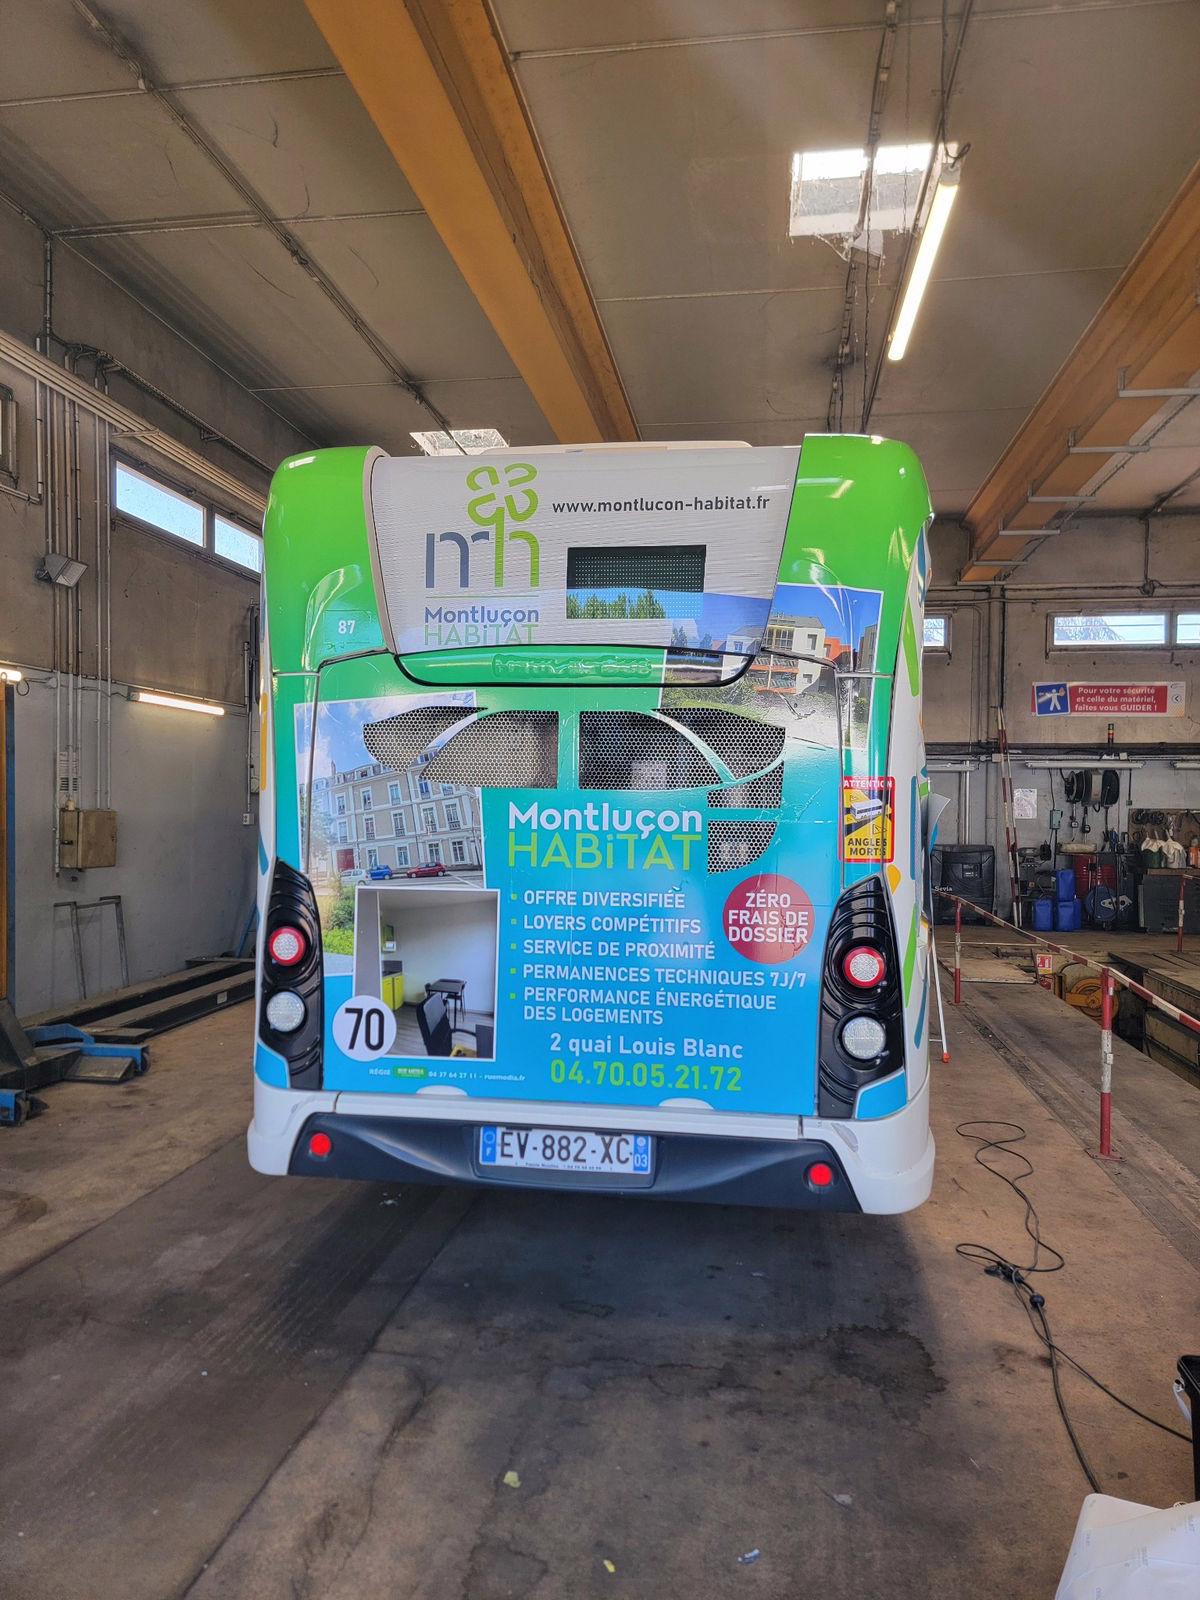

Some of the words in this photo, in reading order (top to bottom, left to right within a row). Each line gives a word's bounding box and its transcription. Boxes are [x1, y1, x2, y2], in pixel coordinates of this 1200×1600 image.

[552, 495, 770, 513] www.montlucon-habitat.fr
[338, 620, 355, 634] 87
[424, 606, 539, 628] Montluçon
[1086, 695, 1105, 703] celle
[1107, 695, 1118, 703] du
[1120, 695, 1156, 704] matériel,
[509, 801, 703, 840] Montluçon
[523, 890, 577, 906] OFFRE
[582, 889, 686, 909] DIVERSIFIÉE
[745, 889, 791, 908] ZÉRO
[523, 914, 586, 931] LOYERS
[591, 914, 701, 934] COMPÉTITIFS
[728, 909, 780, 925] FRAIS
[785, 911, 809, 926] DE
[728, 926, 808, 944] DOSSIER
[523, 939, 593, 956] SERVICE
[597, 941, 620, 957] DE
[625, 940, 716, 960] PROXIMITÉ
[523, 964, 651, 983] PERMANENCES
[654, 968, 765, 987] TECHNIQUES
[769, 971, 807, 990] 7J/7
[523, 987, 650, 1006] PERFORMANCE
[655, 987, 777, 1010] ÉNERGÉTIQUE
[523, 1005, 557, 1021] DES
[561, 1007, 664, 1025] LOGEMENTS
[344, 1008, 385, 1051] 70
[550, 1032, 562, 1051] 2
[568, 1035, 612, 1057] quai
[619, 1035, 676, 1056] Louis
[683, 1038, 744, 1059] Blanc
[369, 1068, 391, 1076] RÉGIE
[550, 1059, 742, 1091] 04.70.05.21.72
[500, 1131, 630, 1165] EV-882-XC
[634, 1153, 648, 1167] 03
